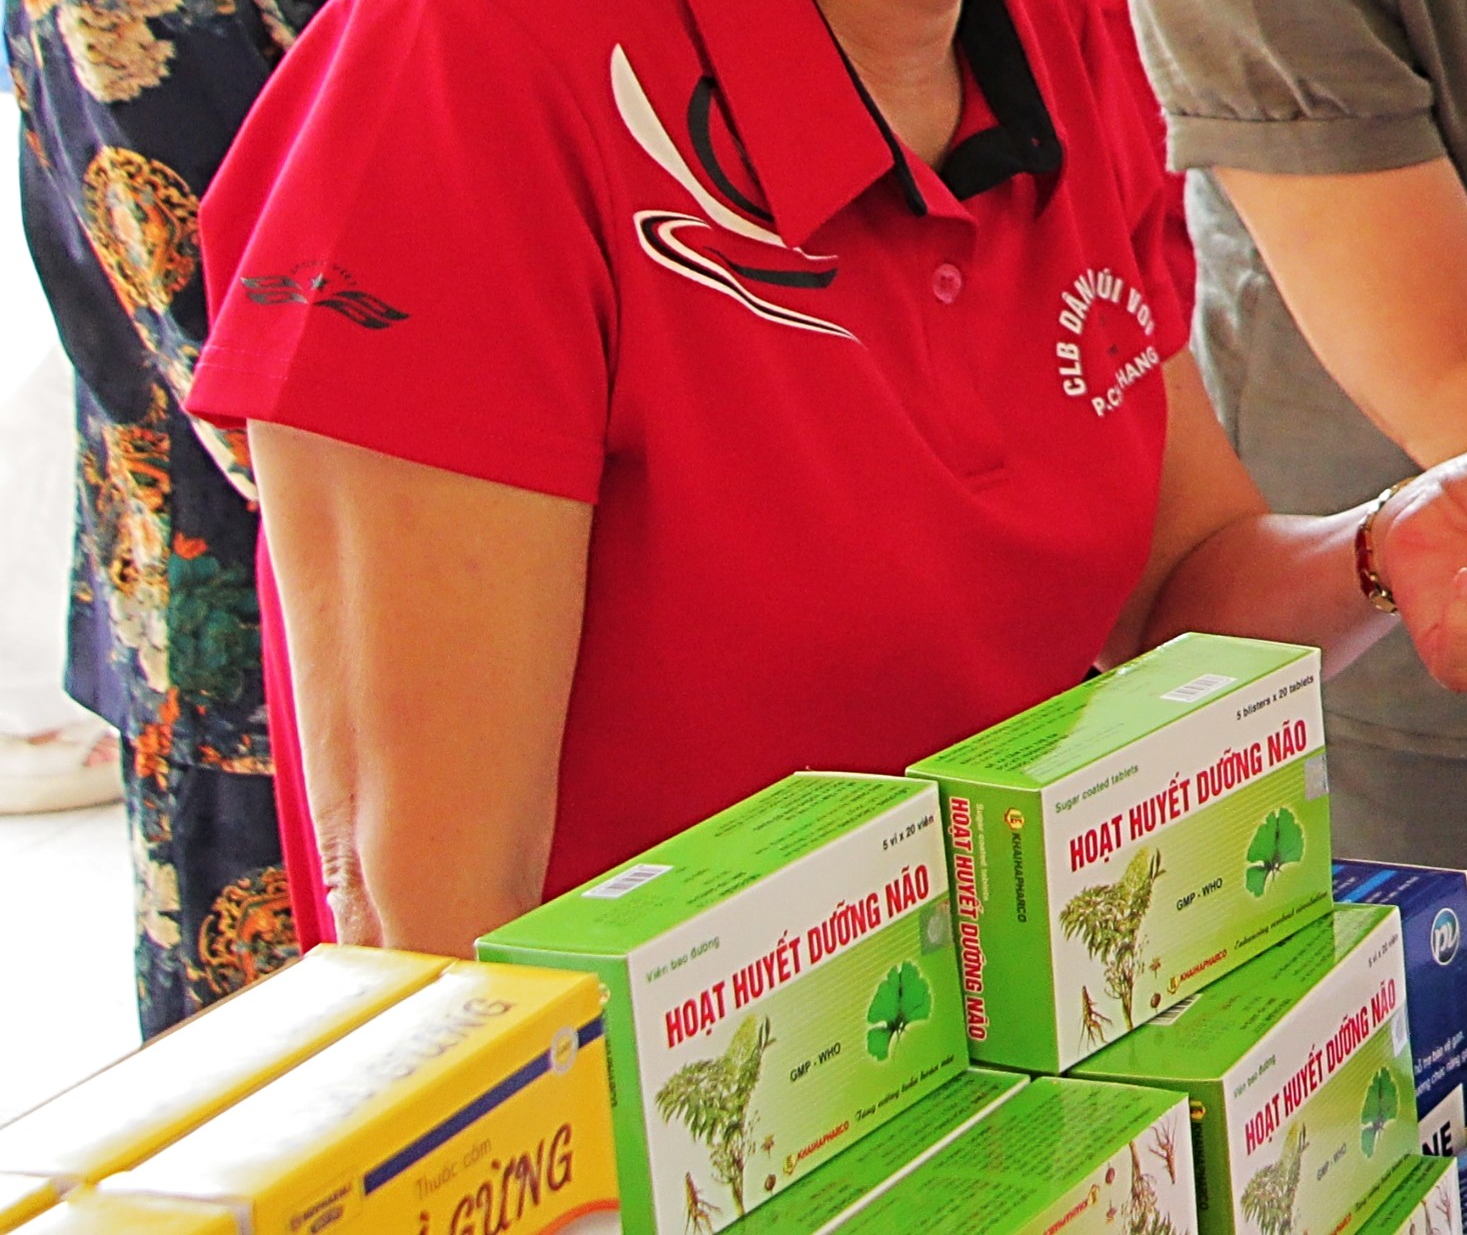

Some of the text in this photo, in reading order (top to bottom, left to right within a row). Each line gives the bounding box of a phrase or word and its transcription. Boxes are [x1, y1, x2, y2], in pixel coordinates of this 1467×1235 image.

[1056, 341, 1087, 396] CLB
[1236, 710, 1242, 720] 5
[1243, 697, 1271, 718] blisters
[1278, 687, 1288, 700] 20
[1289, 675, 1315, 696] tablets
[1055, 764, 1139, 815] Sugar coated tablets
[1069, 719, 1308, 872] HOẠT HUYẾT DƯỠNG NÃO
[883, 839, 889, 851] 5
[906, 823, 916, 839] 20
[918, 814, 935, 833] viên
[949, 796, 990, 1042] HOẠT HUYẾT DƯỠNG NÃO
[1176, 892, 1196, 911] GMP
[1201, 878, 1223, 898] WHO
[646, 963, 669, 983] Viên
[671, 955, 688, 971] bao
[665, 865, 930, 1048] HOẠT HUYẾT DƯỠNG NÃO
[790, 1060, 811, 1082] GMP
[818, 1042, 841, 1064] WHO
[1245, 1093, 1280, 1155] HOẠT
[1283, 1044, 1323, 1118] HUYẾT
[1325, 1006, 1369, 1074] DƯỠNG
[1371, 978, 1396, 1029] NÃO
[449, 1123, 573, 1235] GỪNG
